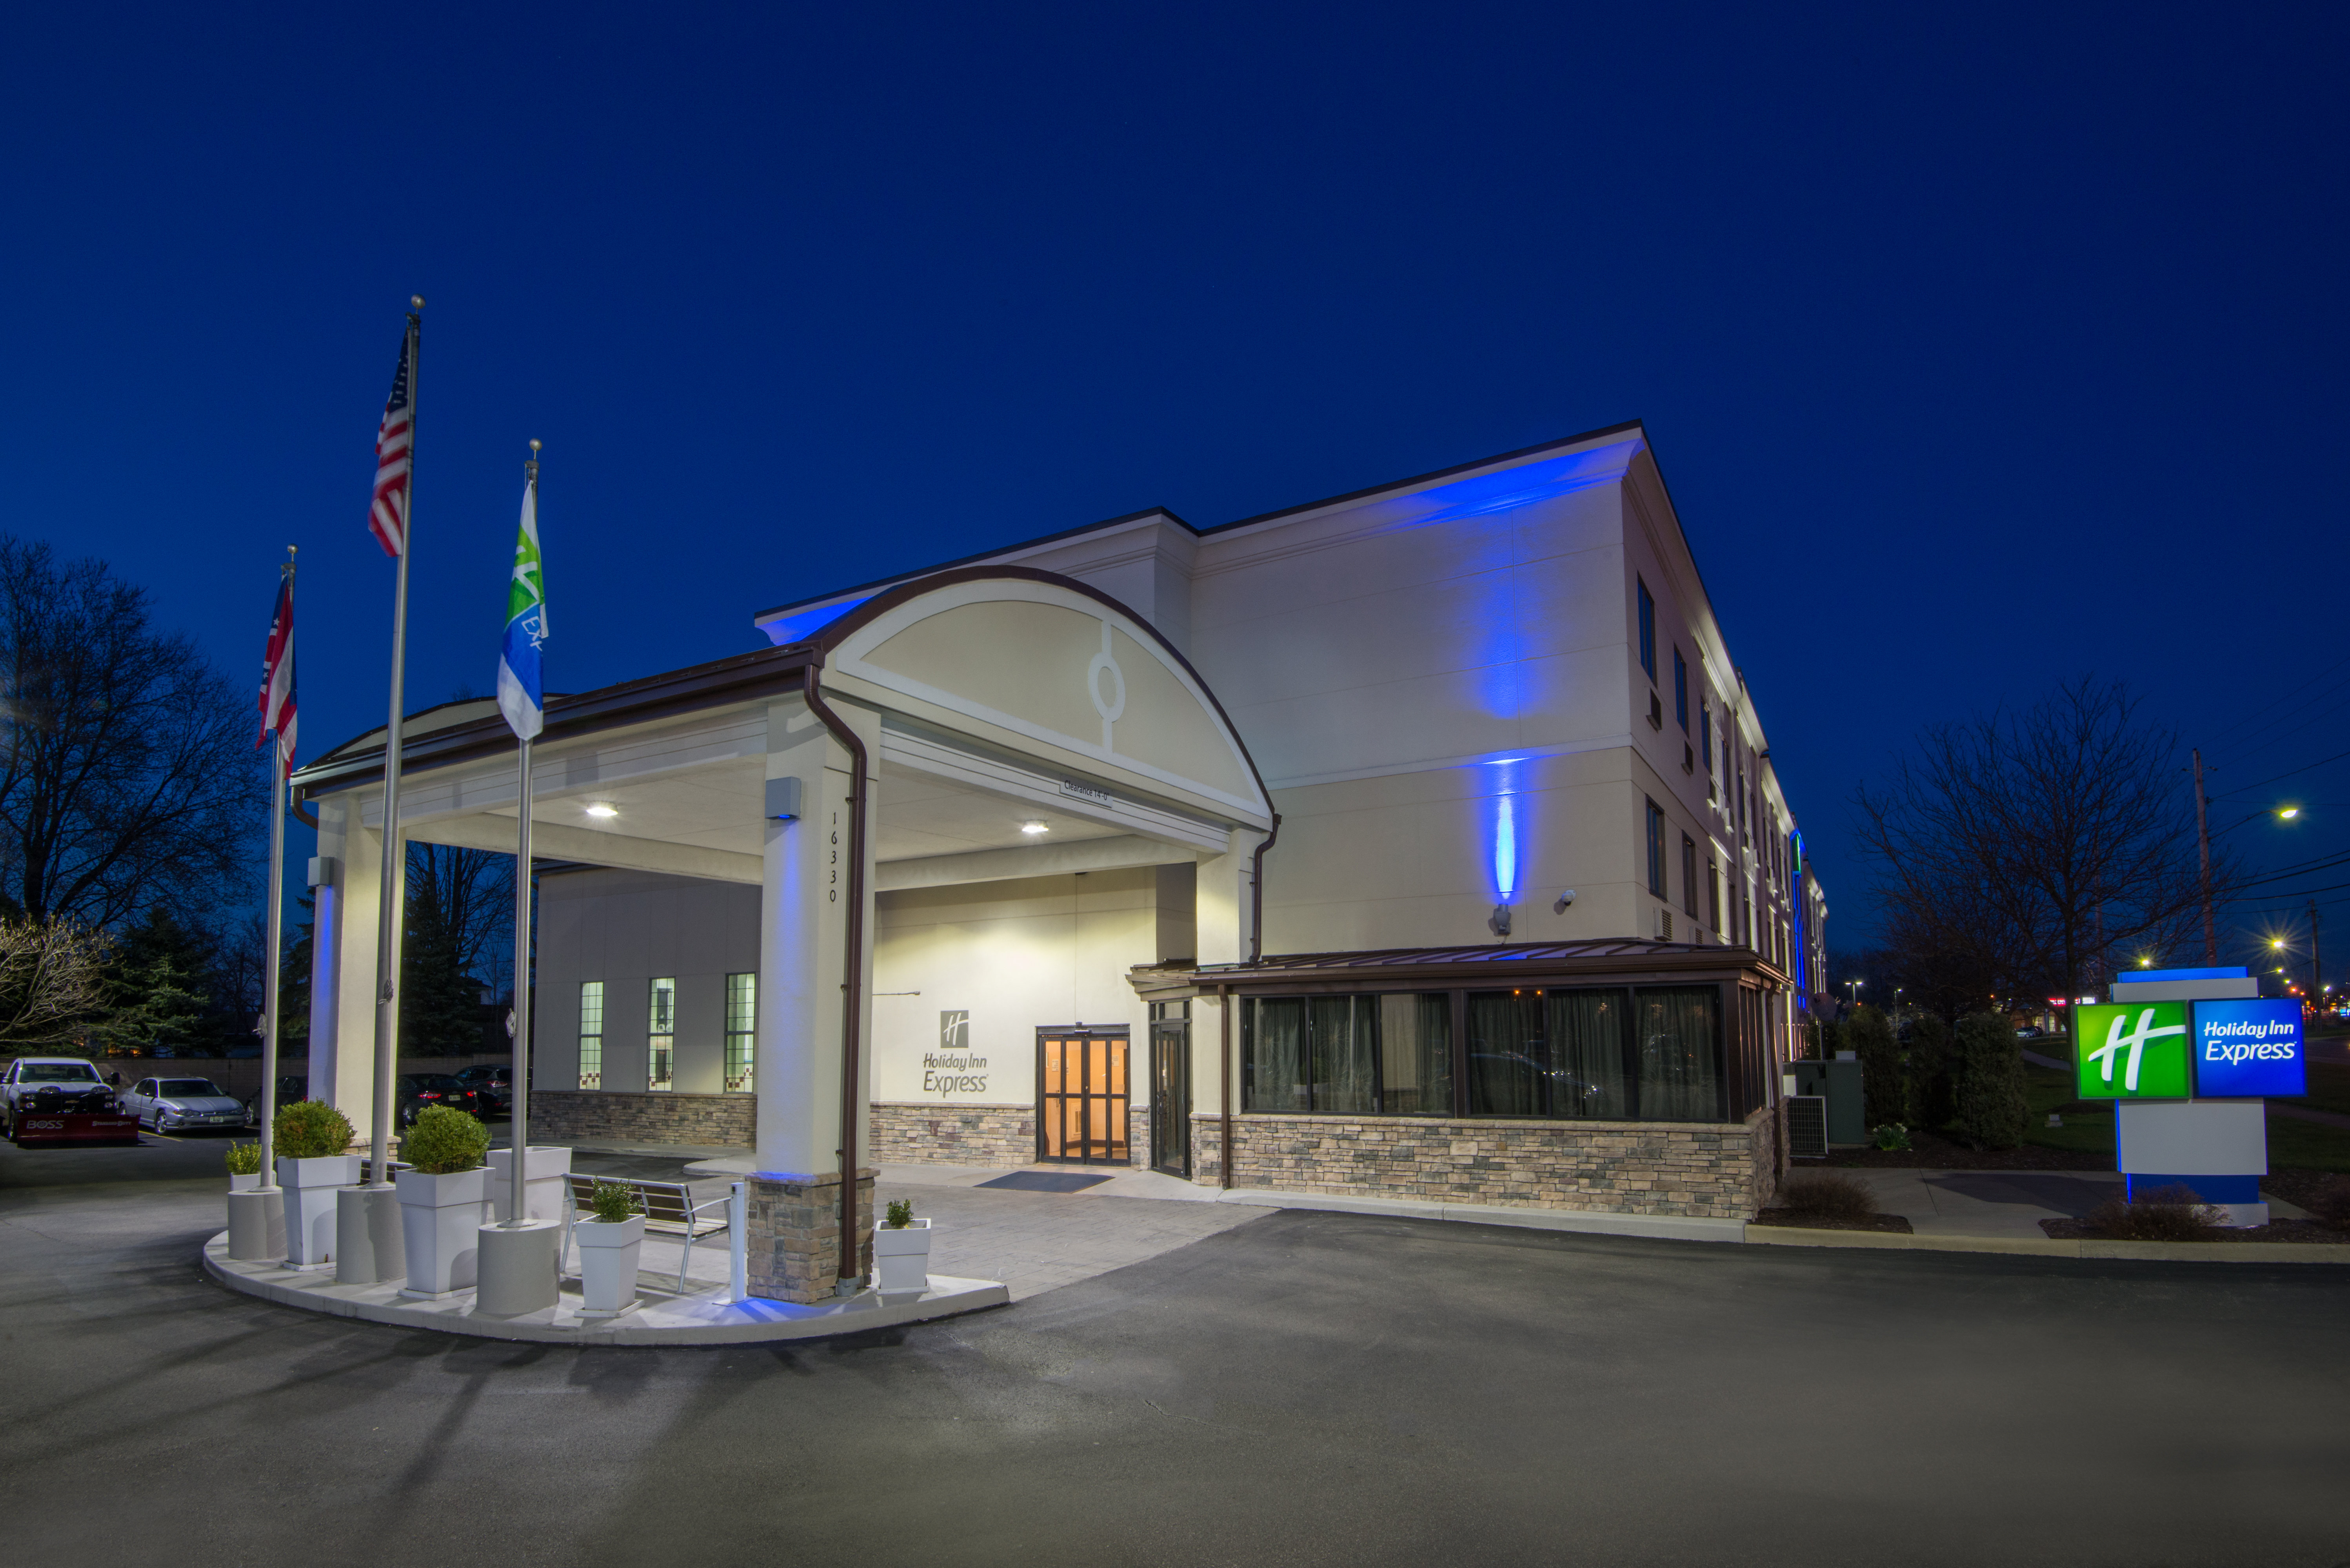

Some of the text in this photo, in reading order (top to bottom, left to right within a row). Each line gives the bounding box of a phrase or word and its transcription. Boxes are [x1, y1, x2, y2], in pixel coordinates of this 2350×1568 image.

[1064, 780, 1092, 797] Clearance
[2203, 1020, 2294, 1039] Holiday Inn
[923, 1053, 987, 1072] Holiday Inn
[2205, 1040, 2295, 1066] Express
[923, 1071, 987, 1098] Express
[26, 1120, 65, 1129] BOSS
